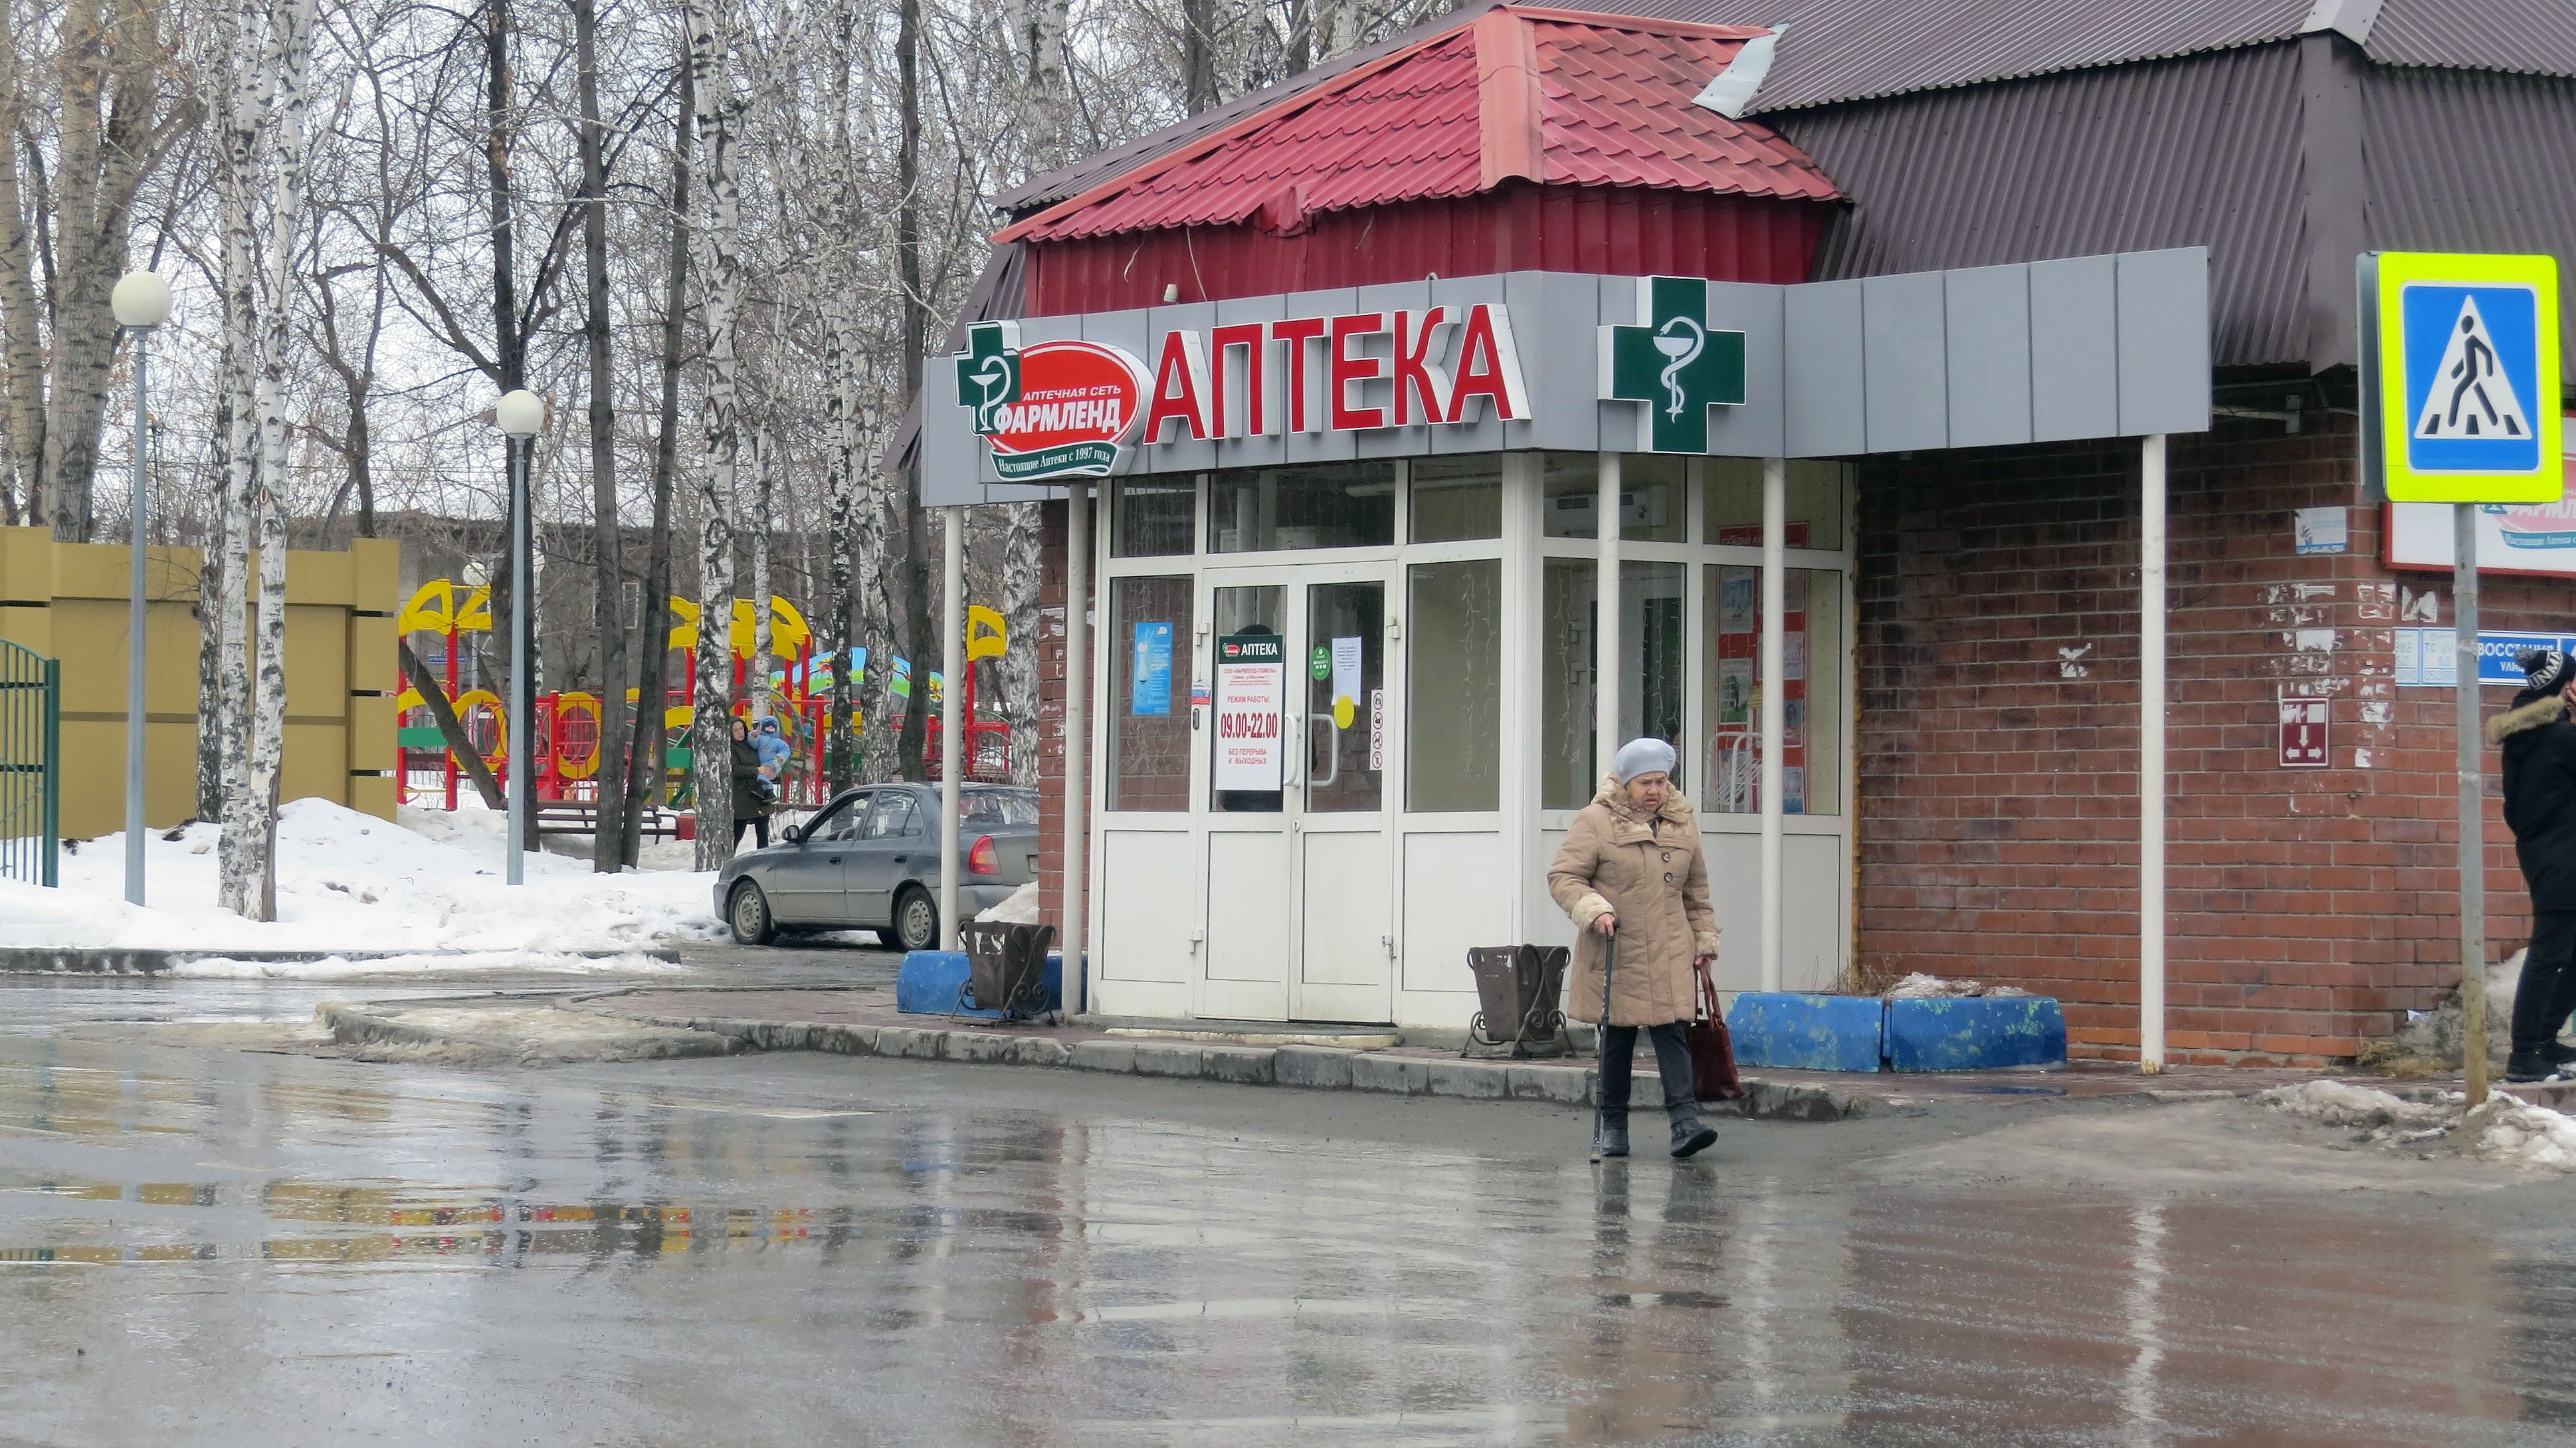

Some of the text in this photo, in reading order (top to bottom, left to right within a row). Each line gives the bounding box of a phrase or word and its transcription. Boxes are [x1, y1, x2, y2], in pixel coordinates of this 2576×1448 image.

[1143, 303, 1518, 445] АПТЕКА
[1023, 385, 1121, 401] АПТЕЧНАЯ СЕТЬ
[993, 399, 1120, 435] ФАРМЛЕНД
[998, 458, 1039, 473] Настоящие
[1040, 454, 1068, 468] Аптеки
[1075, 447, 1093, 460] 1997
[1094, 450, 1111, 463] года
[1241, 643, 1278, 656] АПТЕКА
[1221, 712, 1277, 738] 09.00-22.00
